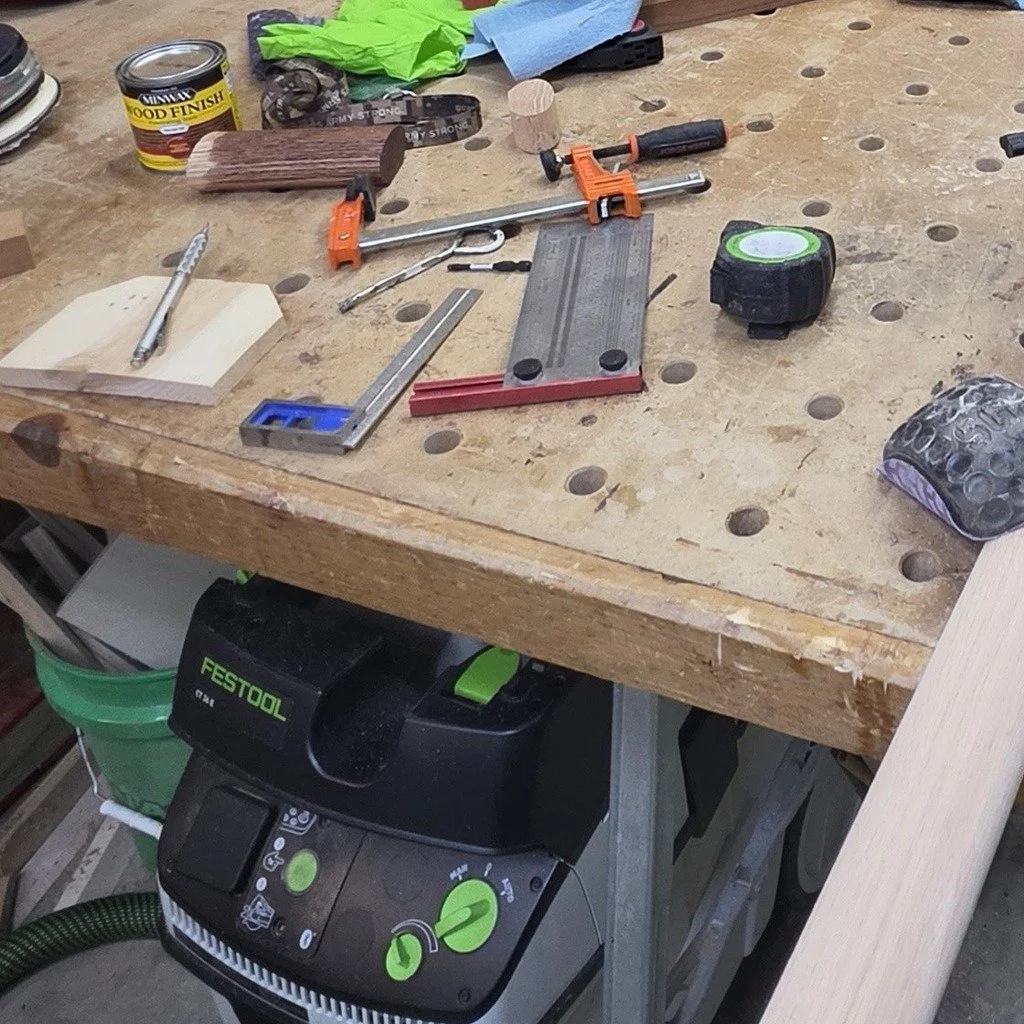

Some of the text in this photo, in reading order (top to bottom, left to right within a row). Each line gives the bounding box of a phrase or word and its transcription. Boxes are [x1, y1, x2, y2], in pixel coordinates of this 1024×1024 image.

[142, 90, 192, 105] MINWAX
[171, 89, 224, 118] FINISH
[358, 107, 402, 120] STRONG
[405, 121, 468, 141] RMY STRONG
[201, 656, 287, 722] FESTOOL
